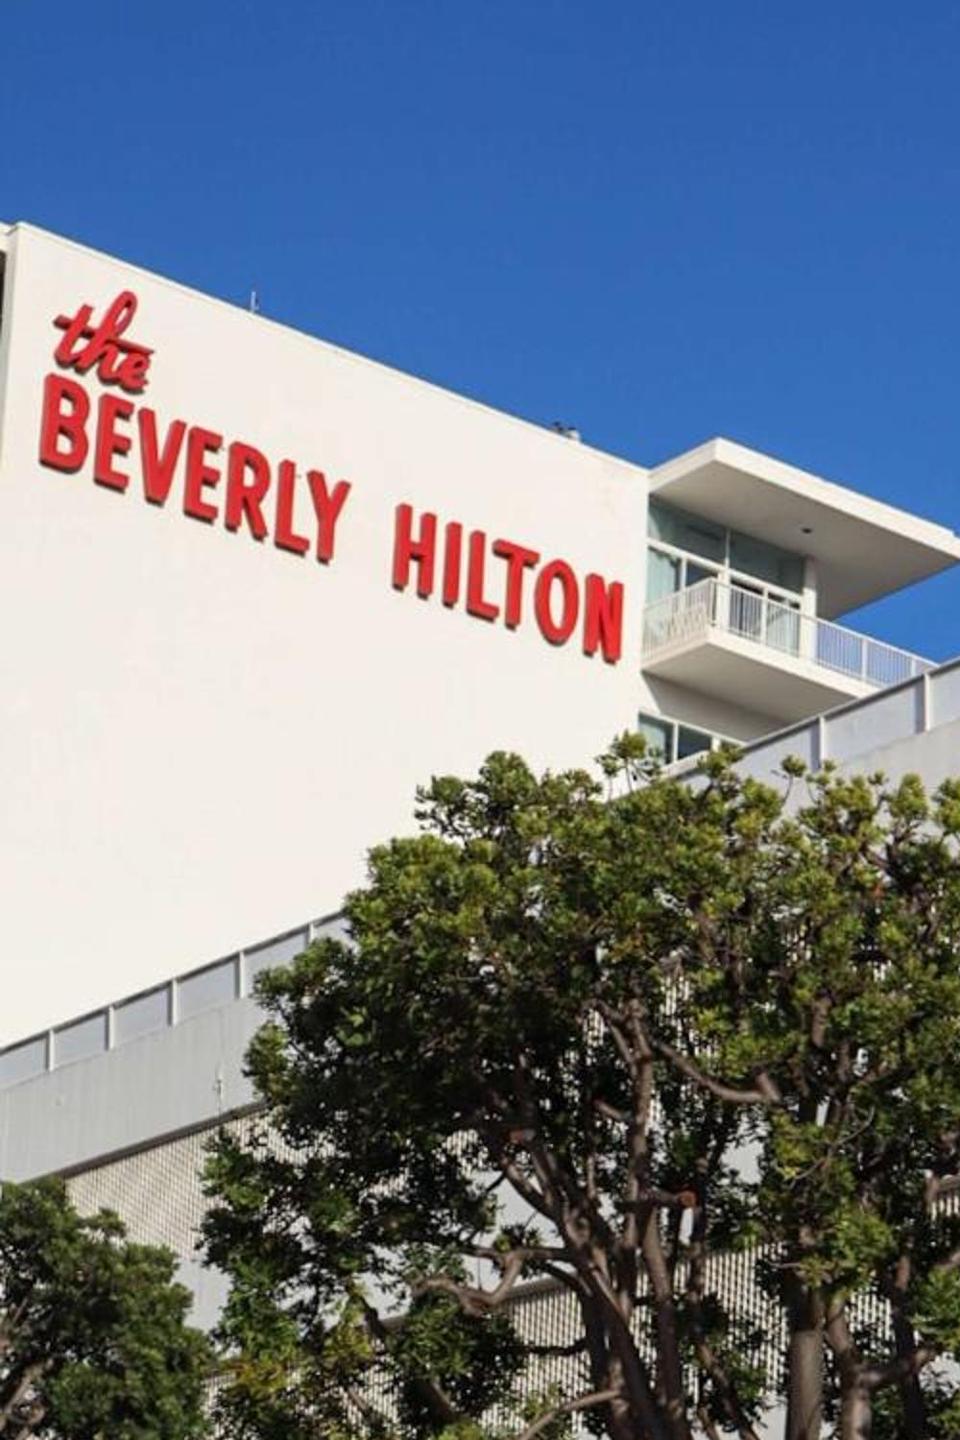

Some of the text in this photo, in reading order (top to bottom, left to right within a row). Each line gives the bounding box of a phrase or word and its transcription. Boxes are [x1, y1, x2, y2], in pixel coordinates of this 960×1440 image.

[53, 290, 153, 394] the
[39, 373, 625, 664] BEVERLY HILTON
